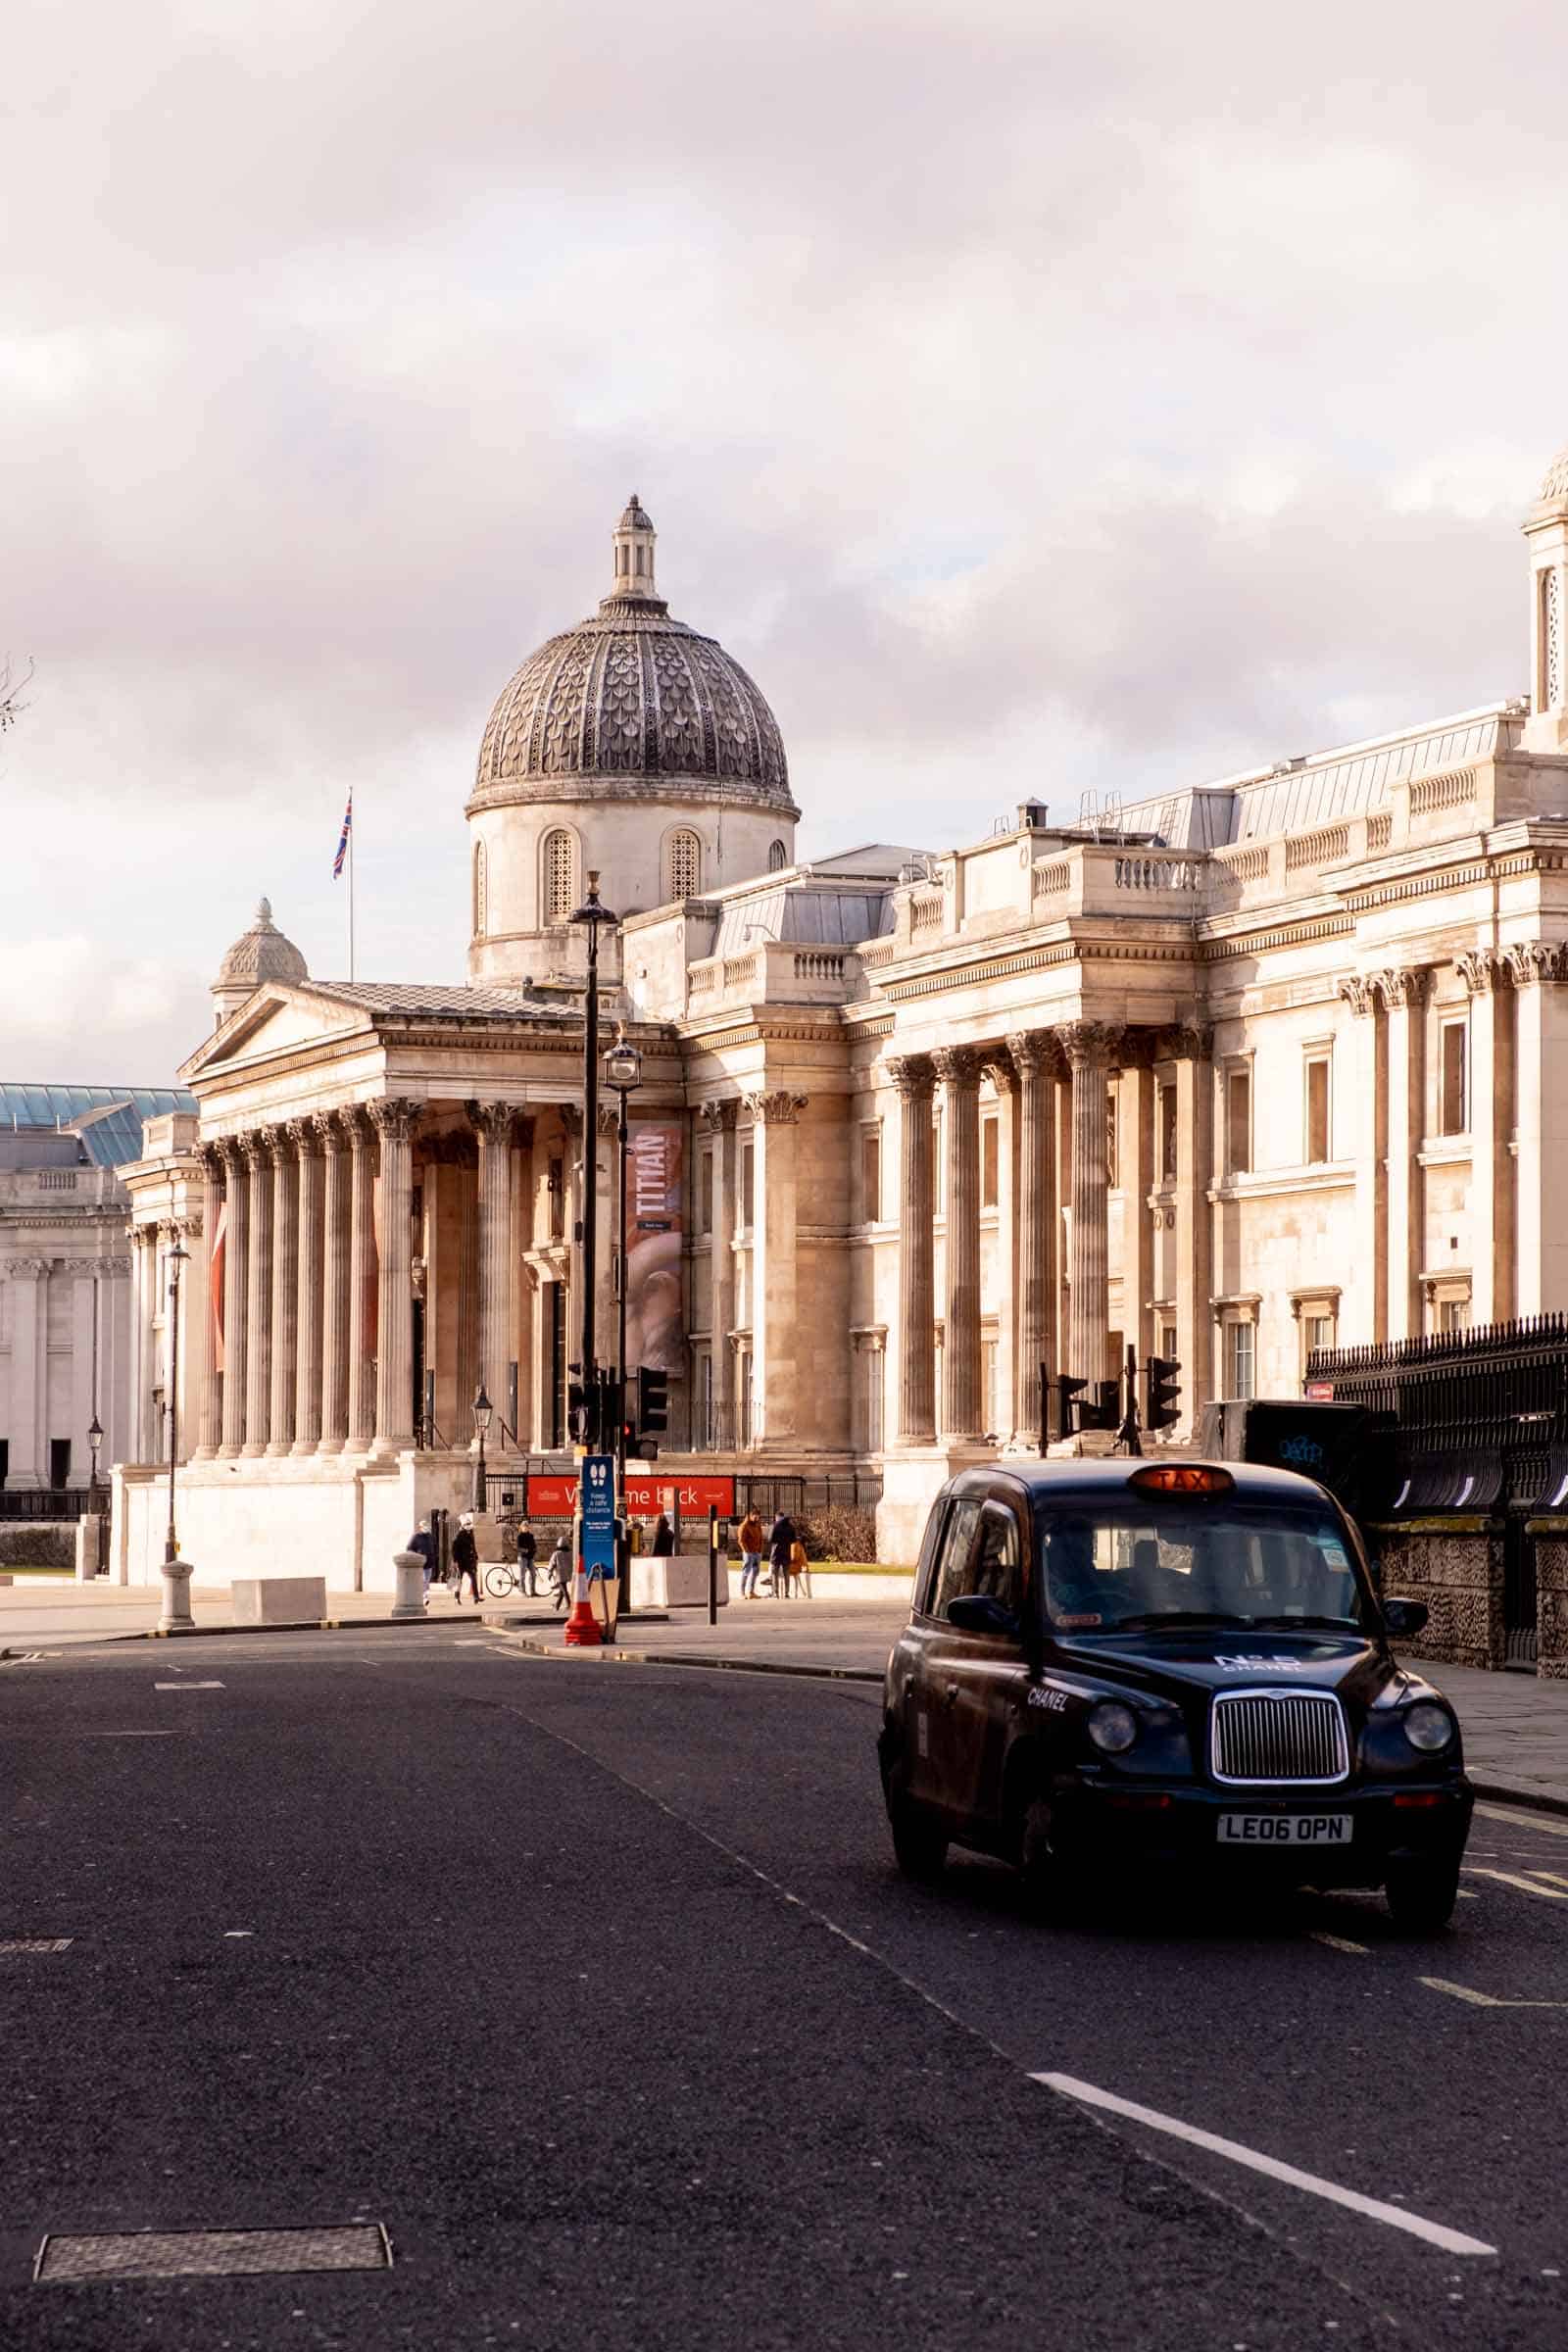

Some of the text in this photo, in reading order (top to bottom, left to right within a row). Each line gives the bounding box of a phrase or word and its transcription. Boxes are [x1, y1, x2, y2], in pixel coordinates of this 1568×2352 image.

[635, 1136, 665, 1216] TITIAN
[1156, 1471, 1215, 1491] TAXI
[656, 1486, 698, 1505] bck
[1027, 1687, 1069, 1712] CHANEL
[1226, 1816, 1344, 1840] LE06 OPN
